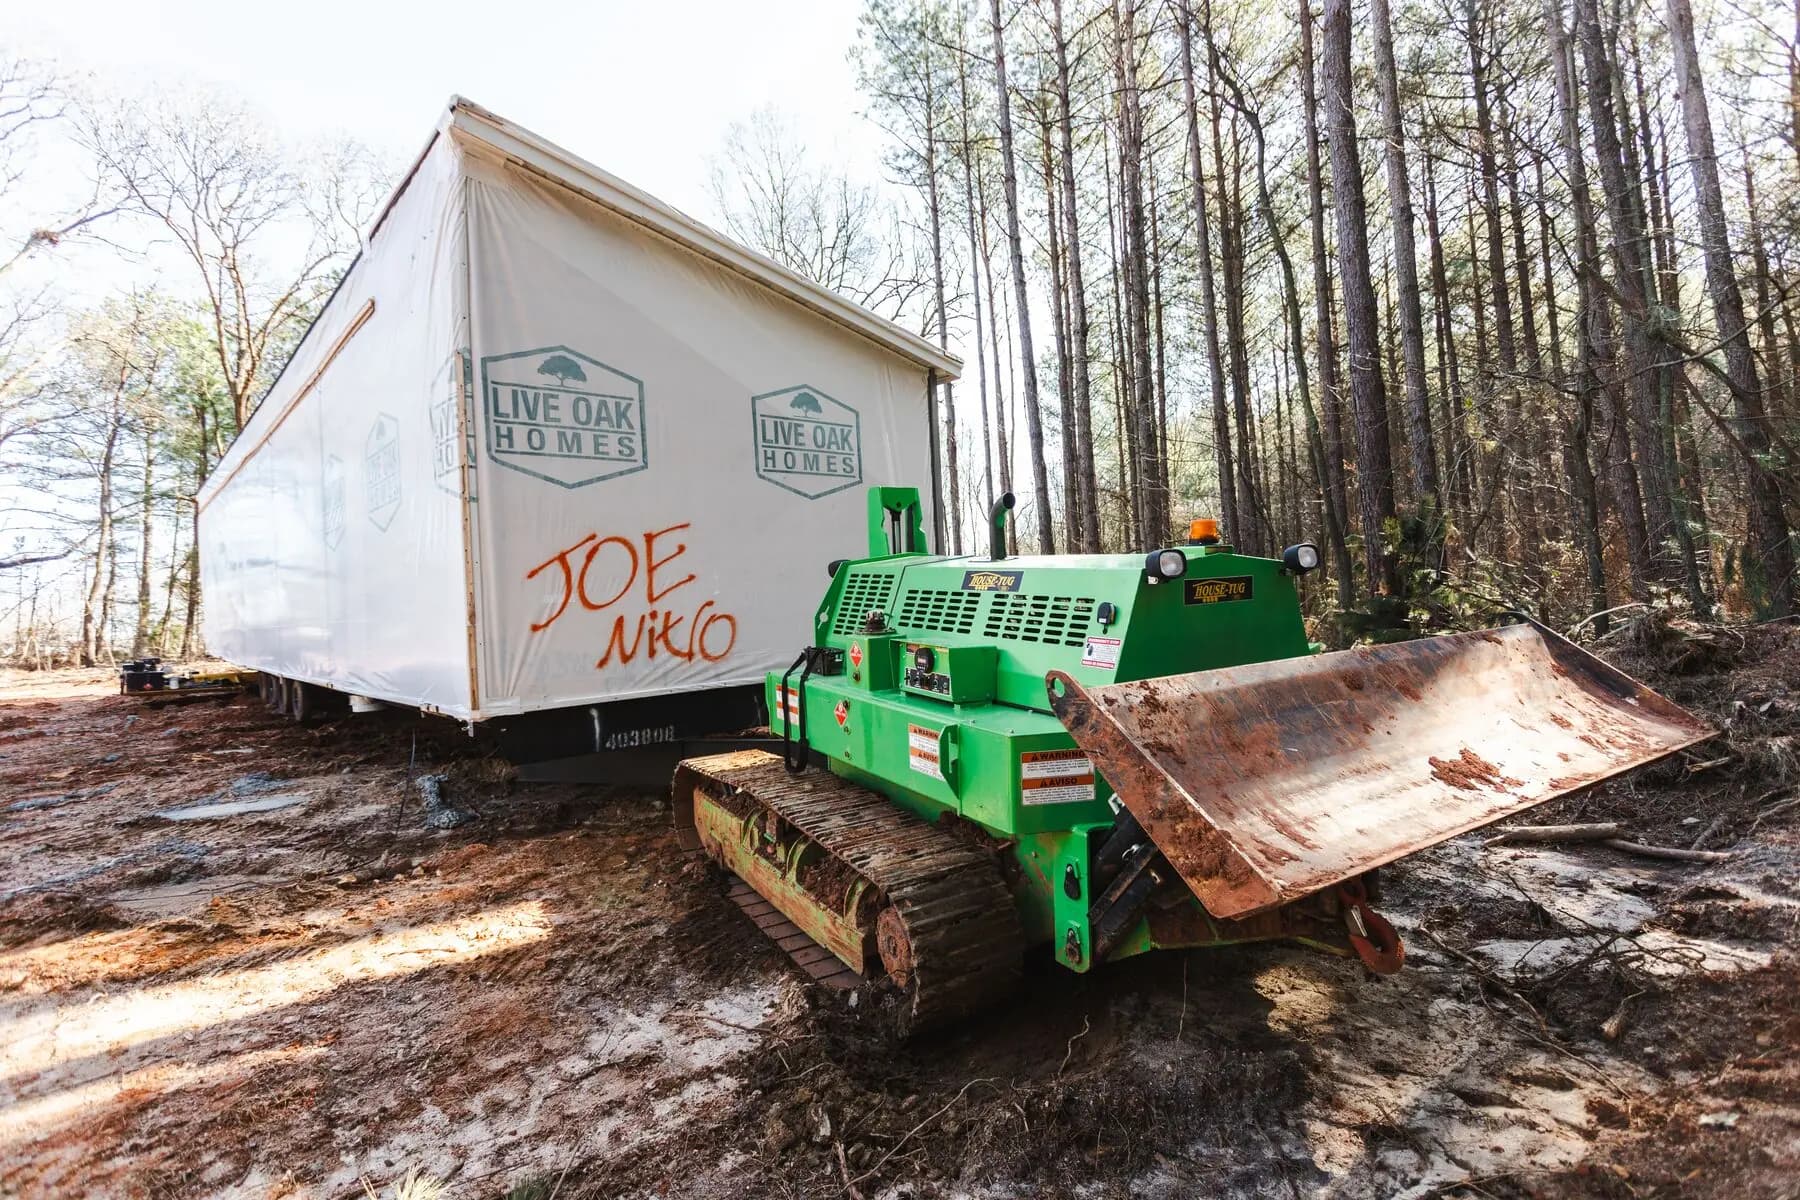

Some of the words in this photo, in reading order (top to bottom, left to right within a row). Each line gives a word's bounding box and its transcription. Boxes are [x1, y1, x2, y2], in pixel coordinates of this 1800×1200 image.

[492, 386, 561, 423] LIVE
[572, 396, 635, 431] OAK
[494, 425, 636, 458] HOMES
[761, 418, 806, 447] LIVE
[813, 425, 854, 452] OAK
[763, 449, 854, 474] HOMES
[526, 522, 697, 638] JOE
[1195, 582, 1246, 597] HOUSE-TUG
[918, 728, 939, 740] WARNIN
[1049, 778, 1077, 787] AVISO
